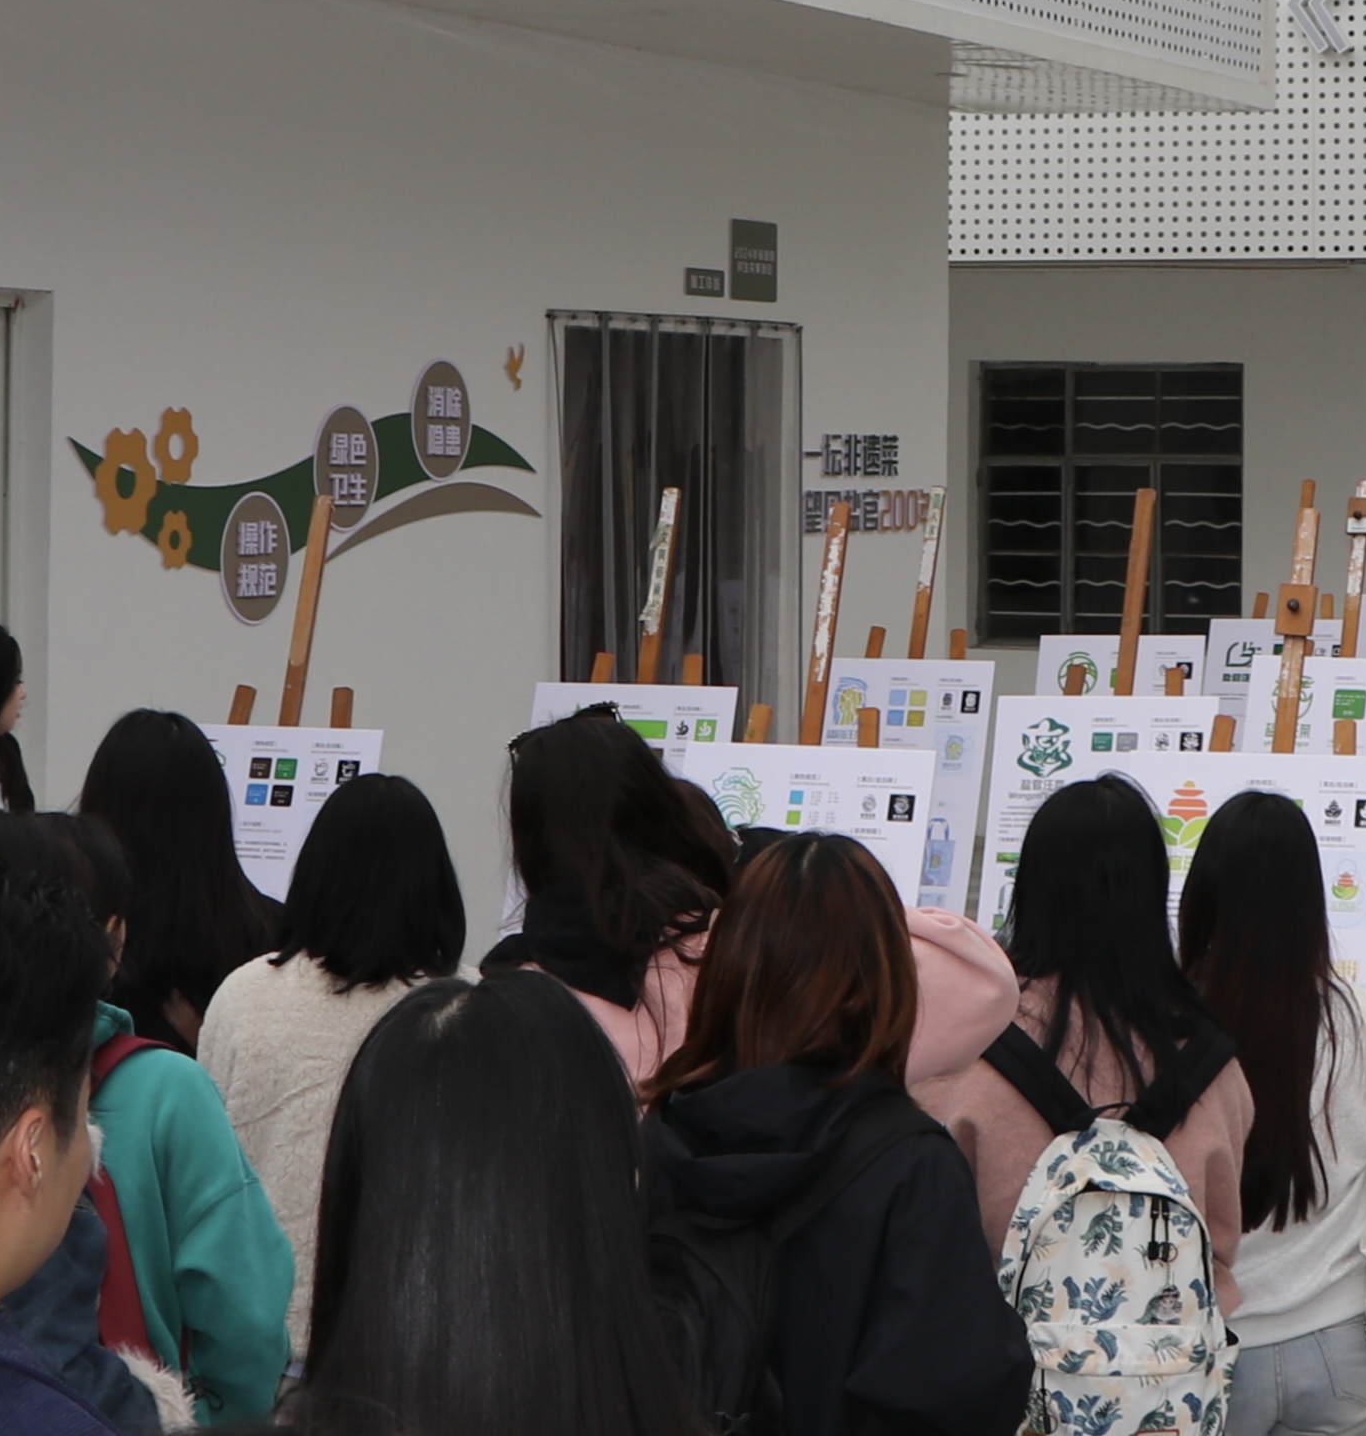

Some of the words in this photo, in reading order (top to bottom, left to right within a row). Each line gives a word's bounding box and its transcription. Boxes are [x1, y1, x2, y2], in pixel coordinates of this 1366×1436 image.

[427, 385, 462, 419] 消除
[329, 432, 367, 465] 绿色
[426, 423, 462, 457] 隐患
[803, 433, 899, 476] 一坛非遗菜
[329, 472, 367, 506] 卫生
[238, 520, 278, 556] 操作
[236, 562, 277, 598] 规范
